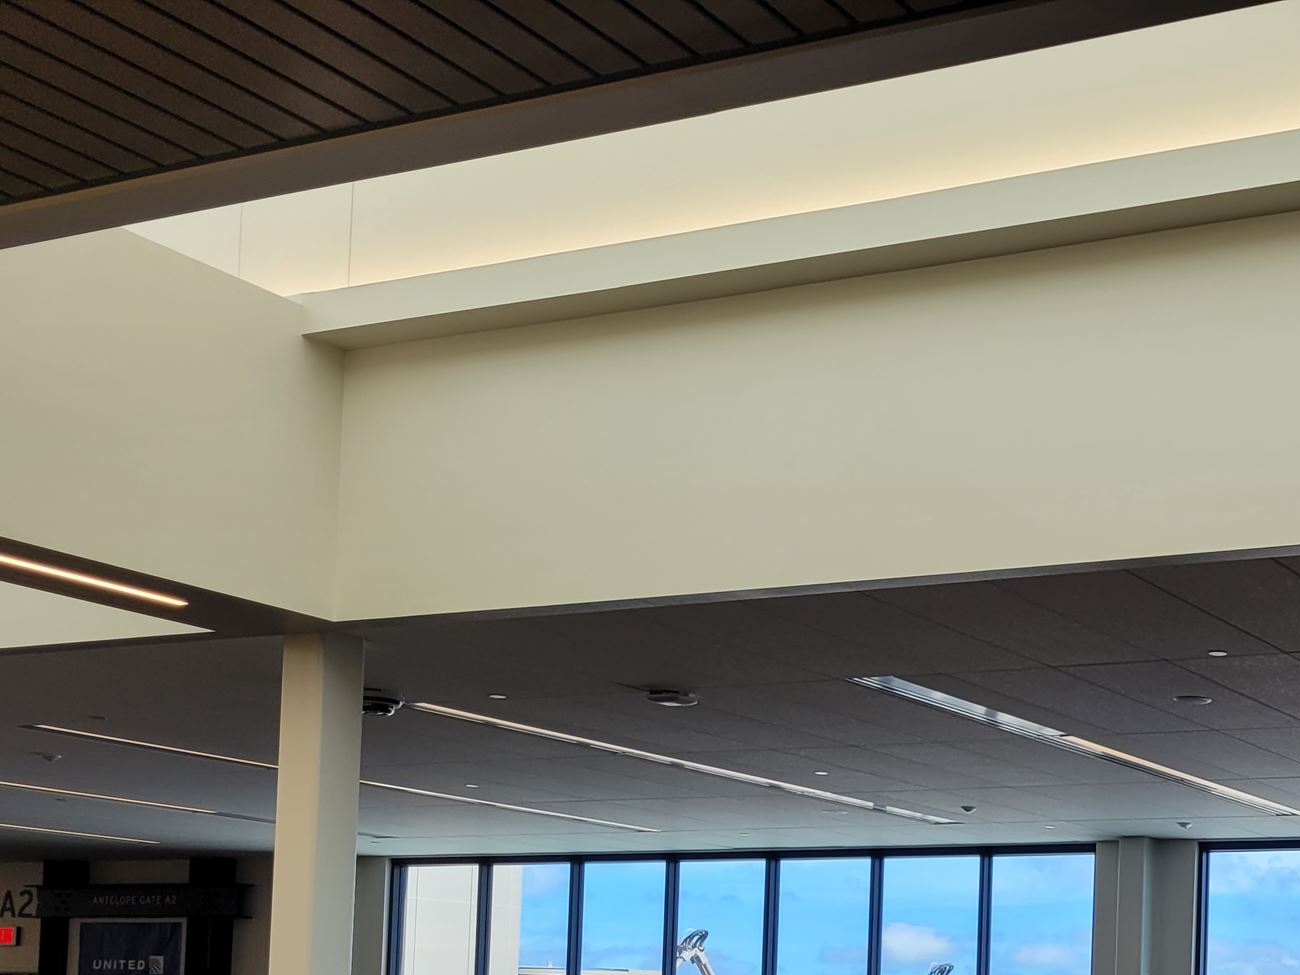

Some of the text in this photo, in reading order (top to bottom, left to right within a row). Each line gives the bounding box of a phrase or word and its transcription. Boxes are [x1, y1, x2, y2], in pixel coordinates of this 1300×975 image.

[0, 889, 34, 918] A2
[92, 895, 177, 905] ANTELOPE GATE A2
[92, 959, 146, 970] UNITED
